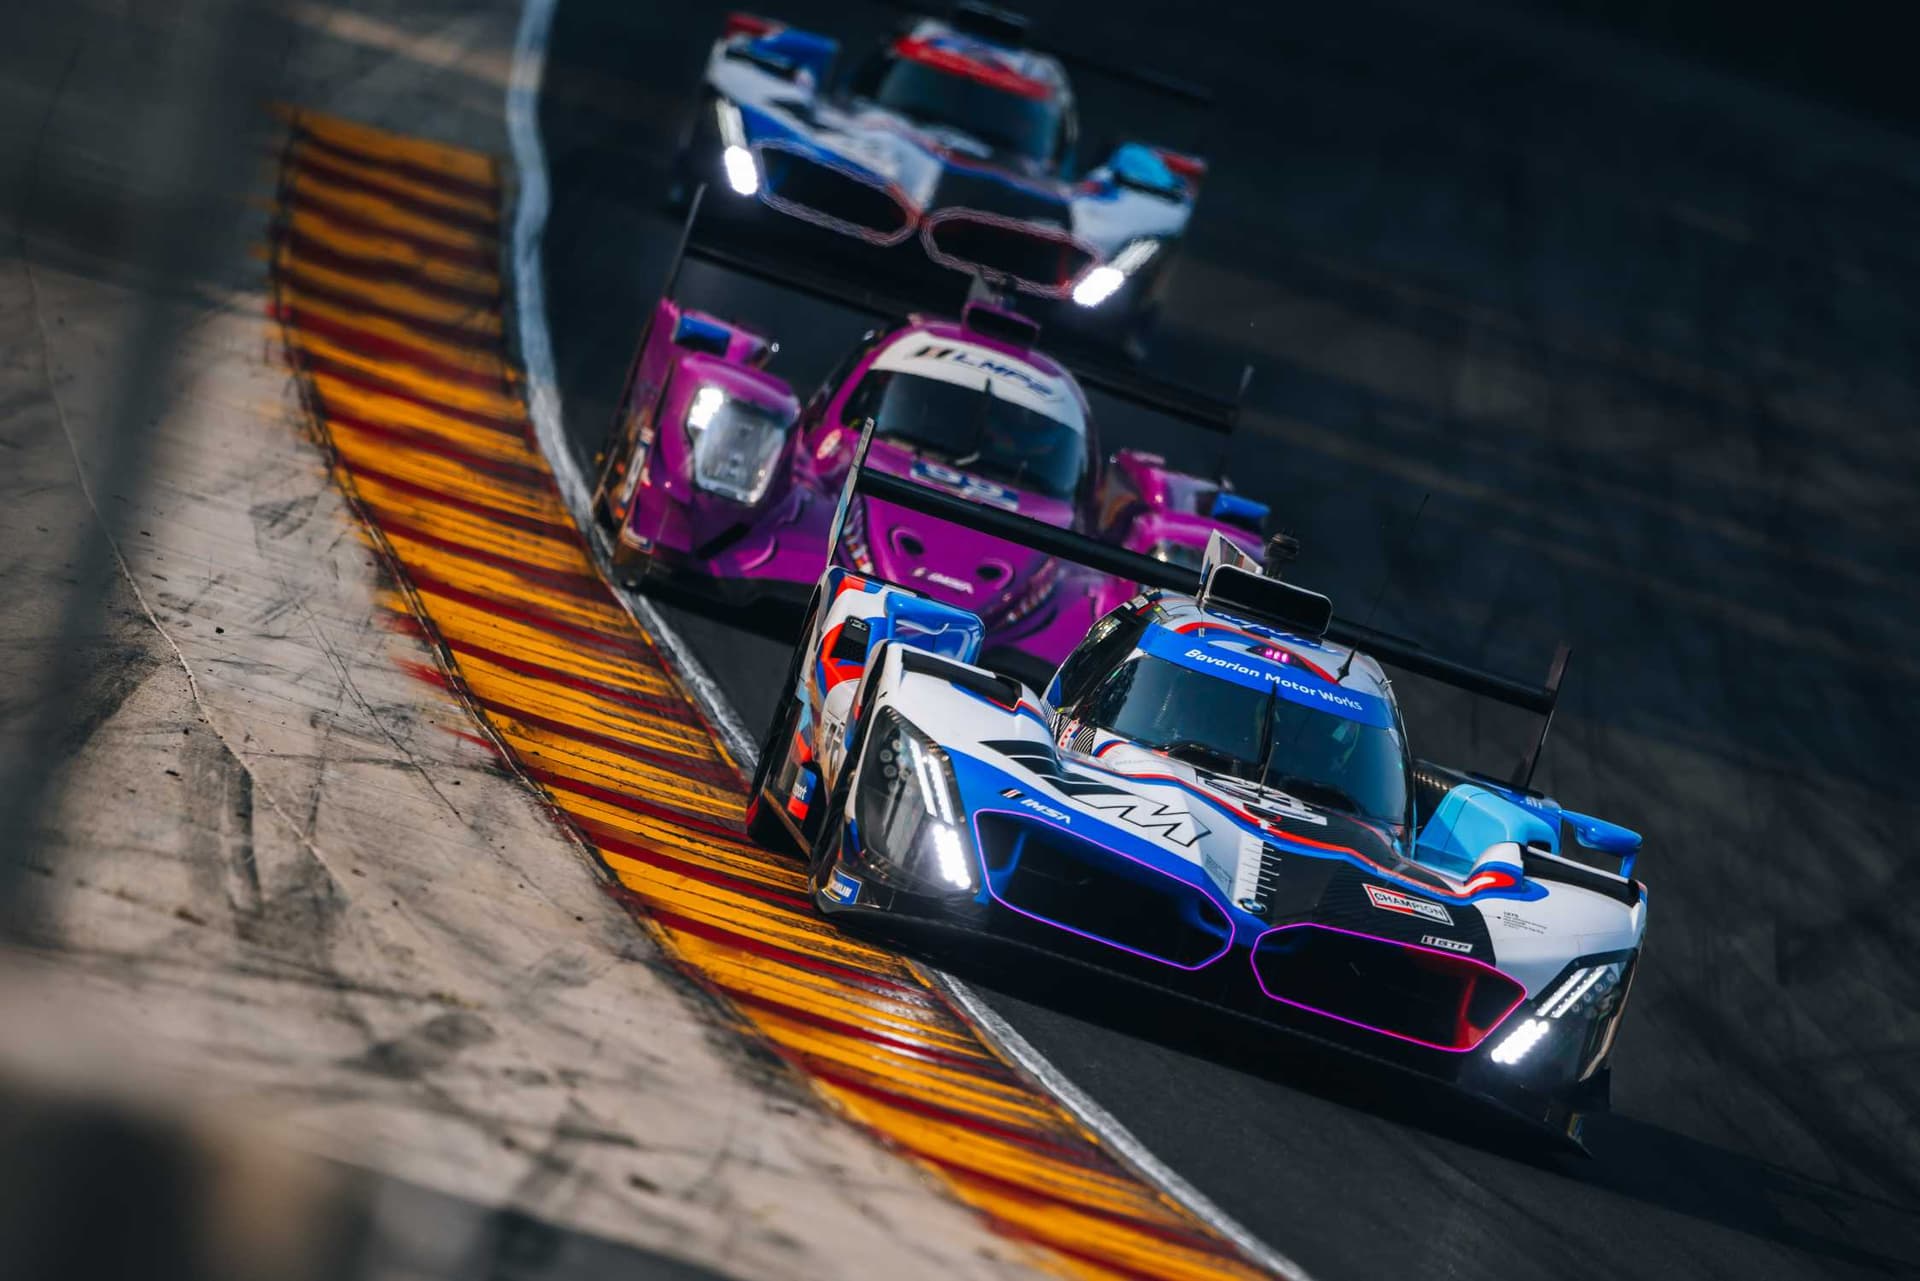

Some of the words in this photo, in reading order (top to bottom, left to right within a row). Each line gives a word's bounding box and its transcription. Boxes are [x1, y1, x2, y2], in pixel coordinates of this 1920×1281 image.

[1184, 648, 1261, 678] Bavarian
[1264, 672, 1317, 697] Motor
[1317, 688, 1364, 712] Works
[1020, 798, 1071, 825] IMSA
[1373, 892, 1451, 922] CHAMPION
[1439, 938, 1470, 951] GTP
